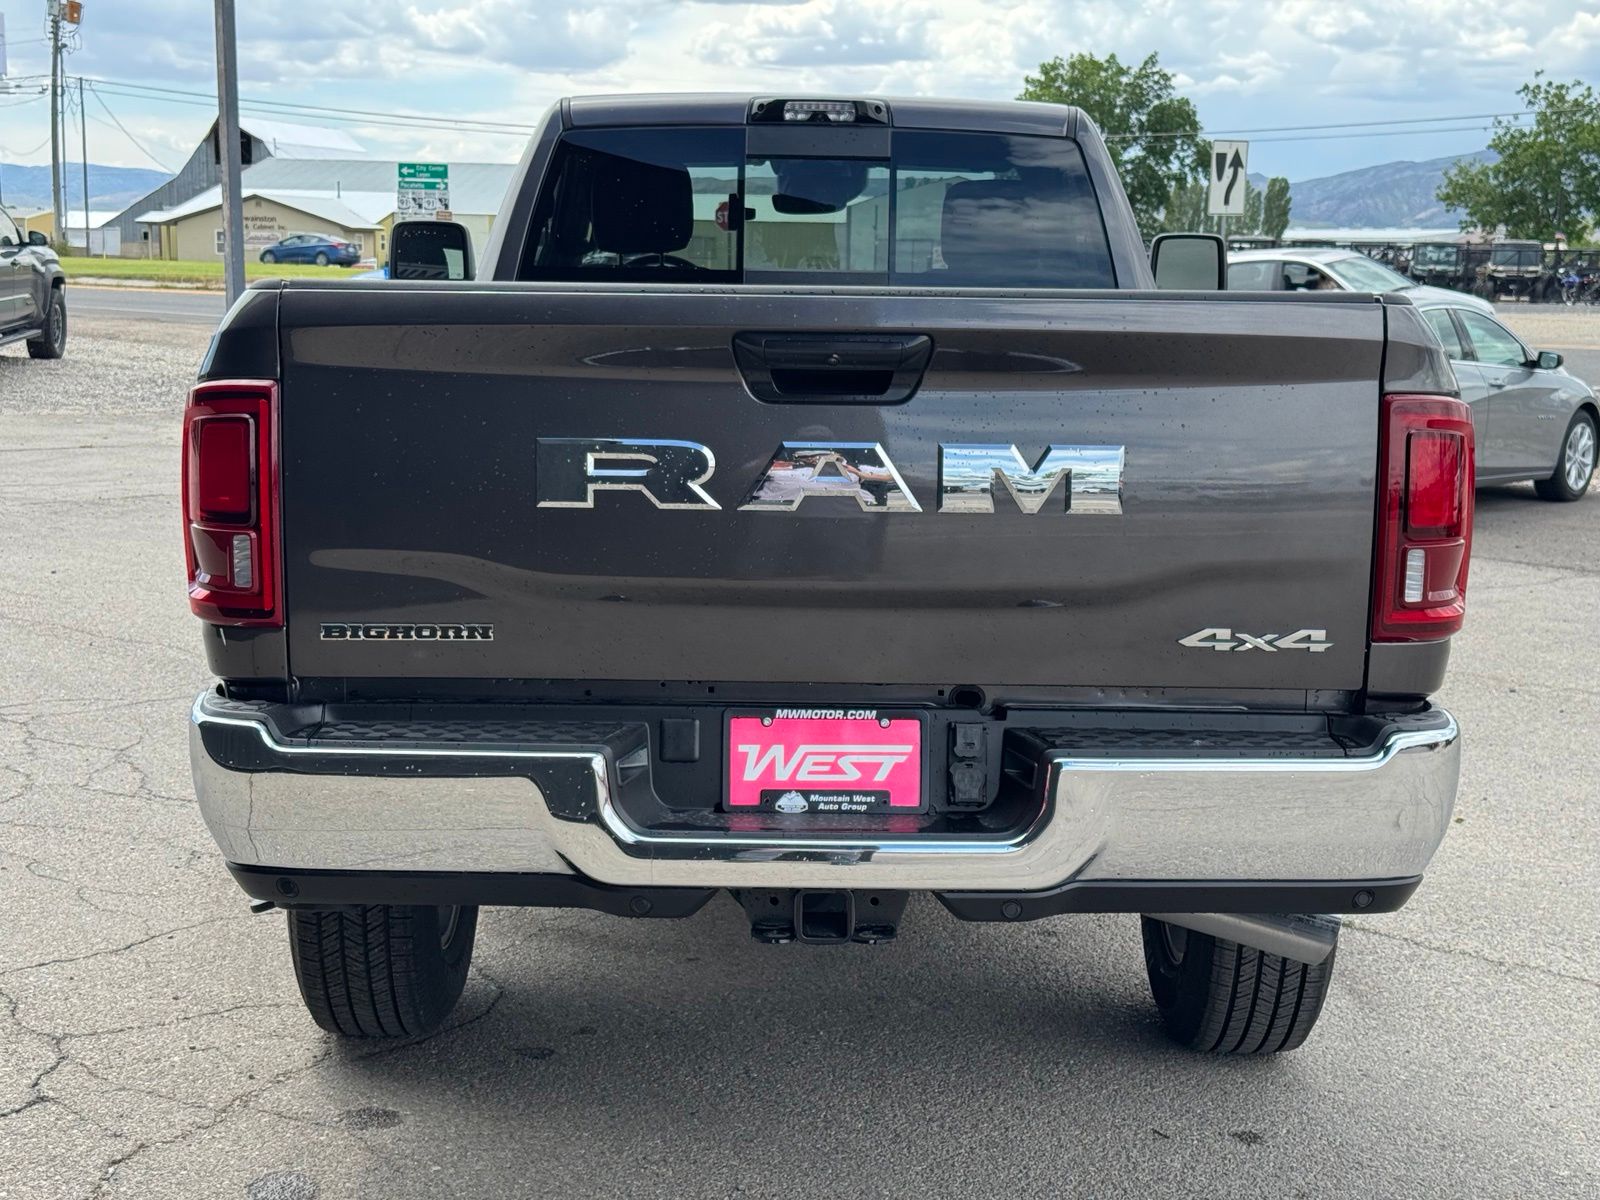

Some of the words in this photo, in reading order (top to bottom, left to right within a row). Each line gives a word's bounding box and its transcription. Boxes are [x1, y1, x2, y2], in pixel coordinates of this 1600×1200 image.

[536, 437, 1126, 515] RAM
[320, 623, 494, 641] BIGHORN
[1178, 628, 1334, 652] 4x4
[775, 709, 876, 720] MWMOTOR.COM
[738, 744, 913, 782] WEST
[809, 794, 850, 803] Mountain
[853, 795, 875, 803] West
[818, 803, 839, 811] Auto
[841, 803, 868, 812] Group
